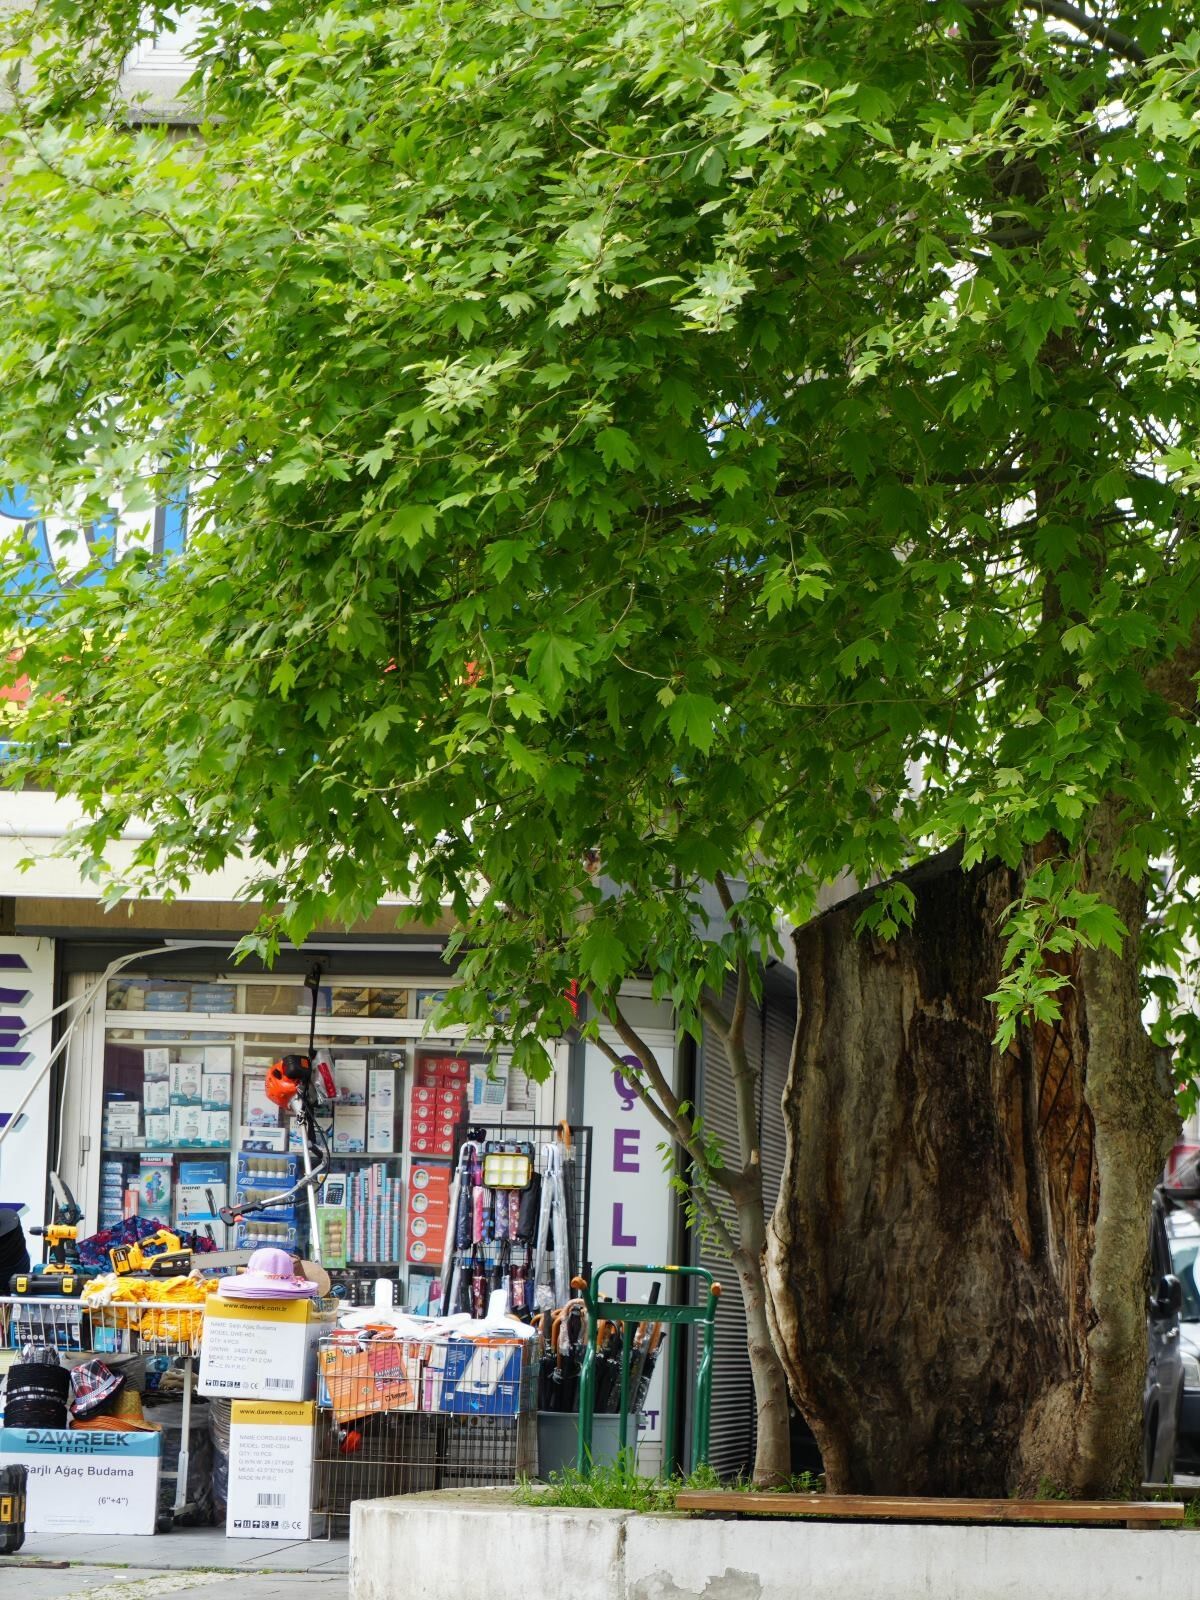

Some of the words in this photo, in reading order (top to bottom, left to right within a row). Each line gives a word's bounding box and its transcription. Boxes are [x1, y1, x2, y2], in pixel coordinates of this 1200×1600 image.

[26, 1430, 129, 1446] DAWREEK
[55, 1465, 84, 1477] Ağaç
[88, 1466, 134, 1477] Budama
